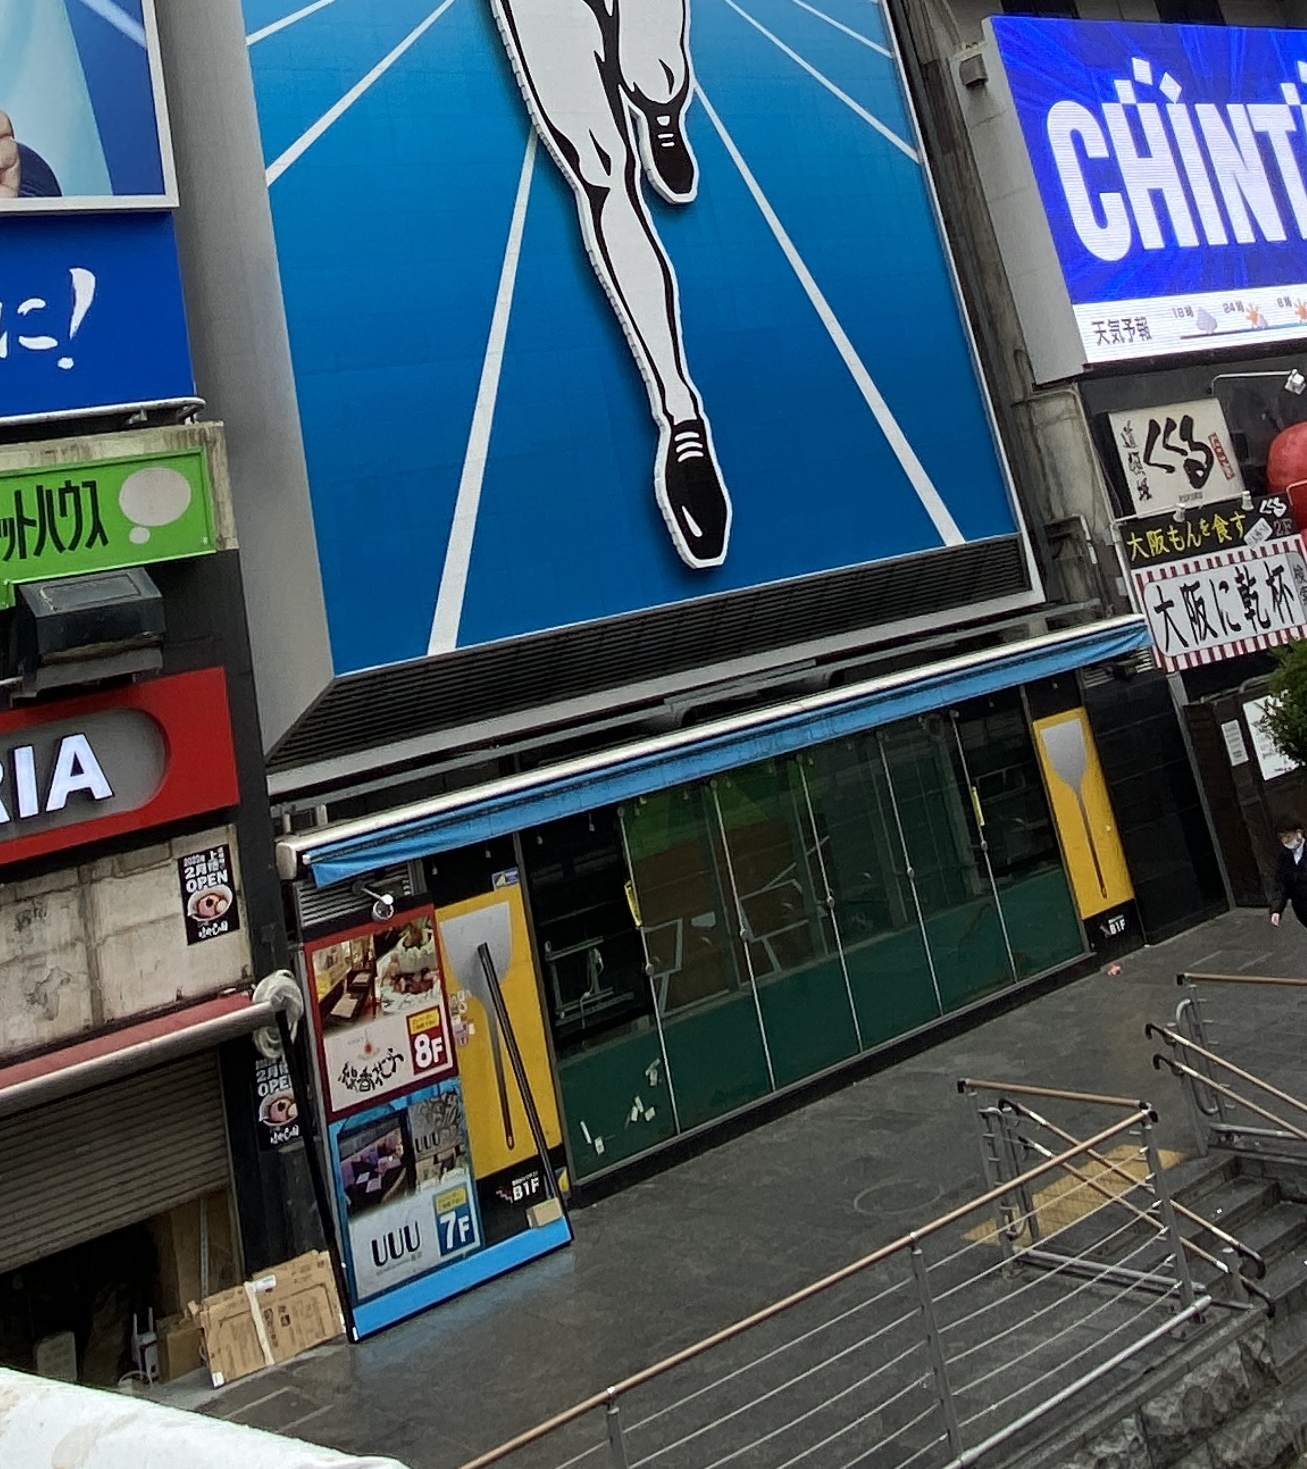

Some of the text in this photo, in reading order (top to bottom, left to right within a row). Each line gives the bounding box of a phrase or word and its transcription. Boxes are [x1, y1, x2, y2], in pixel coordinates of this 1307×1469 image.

[1090, 315, 1152, 346] 天気予報
[1143, 414, 1215, 490] くくる
[1126, 510, 1247, 563] 大阪もんを食す
[1153, 557, 1295, 653] 大阪に乾杯
[185, 869, 229, 894] OPEN
[1109, 918, 1126, 936] B1F
[413, 1033, 445, 1069] 8F
[512, 1176, 540, 1203] B1F
[371, 1220, 423, 1268] UUU
[439, 1211, 471, 1250] 7F
